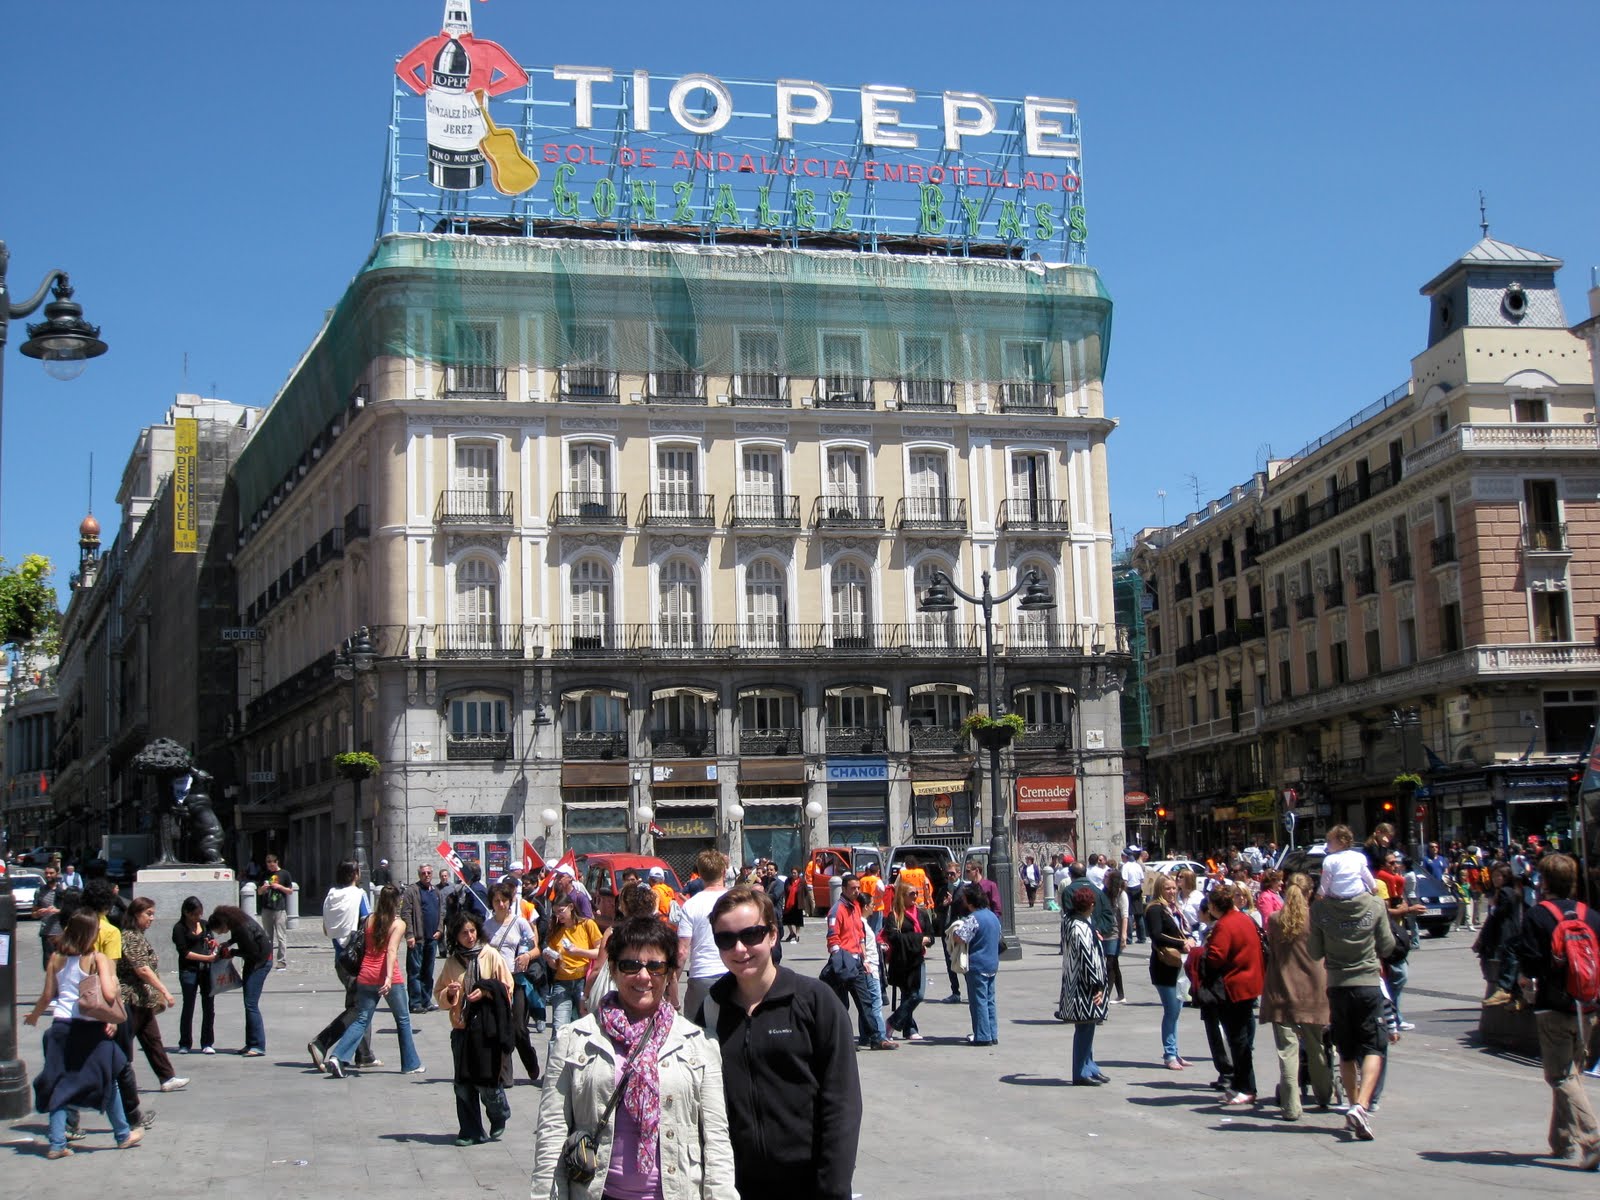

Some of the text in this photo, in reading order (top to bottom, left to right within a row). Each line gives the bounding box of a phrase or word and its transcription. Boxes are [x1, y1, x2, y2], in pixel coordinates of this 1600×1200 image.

[553, 64, 1080, 158] TIO PEPE
[443, 124, 473, 134] JEREZ
[432, 149, 450, 161] FINO
[454, 154, 468, 162] MUY
[543, 143, 1082, 192] SOL DE ANDALUCIA EMBOTELLADO
[552, 163, 1088, 243] GONZALEZ BYASS
[176, 456, 186, 530] DESNIVEL
[224, 630, 264, 639] HOTEL
[830, 766, 885, 778] CHANGE
[1020, 785, 1071, 798] Cremades
